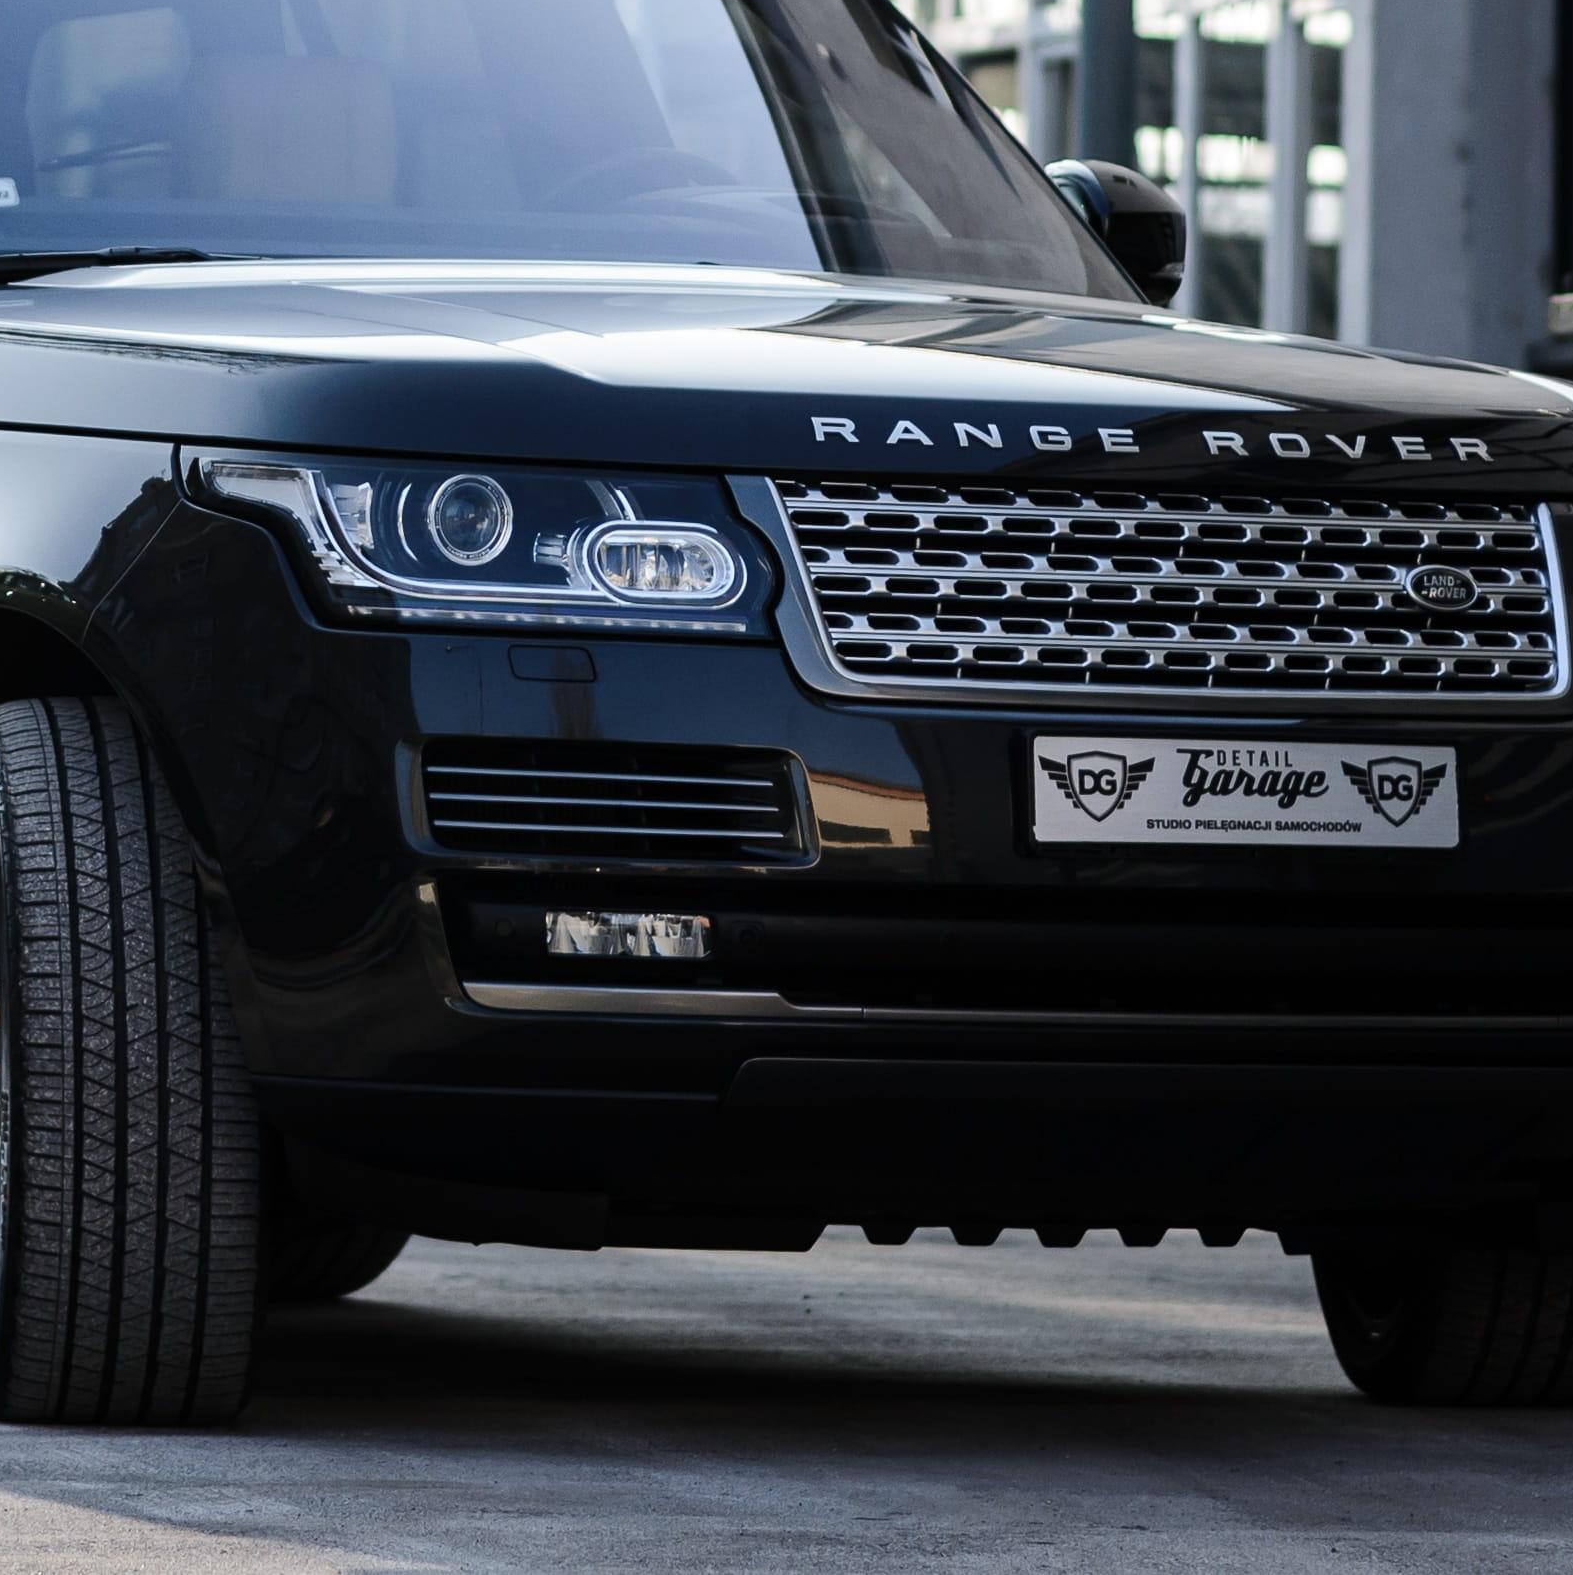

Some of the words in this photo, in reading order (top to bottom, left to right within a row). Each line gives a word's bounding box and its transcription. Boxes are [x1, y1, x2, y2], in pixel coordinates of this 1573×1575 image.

[810, 416, 1141, 453] RANGE
[1201, 430, 1495, 462] ROVER
[1423, 575, 1455, 587] LAND
[1428, 587, 1467, 599] ROVER
[1216, 749, 1293, 767] DETAIL
[1078, 768, 1118, 796] DG
[1176, 748, 1330, 809] Garage
[1377, 774, 1414, 801] DG
[1146, 818, 1192, 830] STUDIO
[1194, 819, 1272, 833] PIELĘGNACJI
[1274, 819, 1362, 833] SAMOCHODÓW
